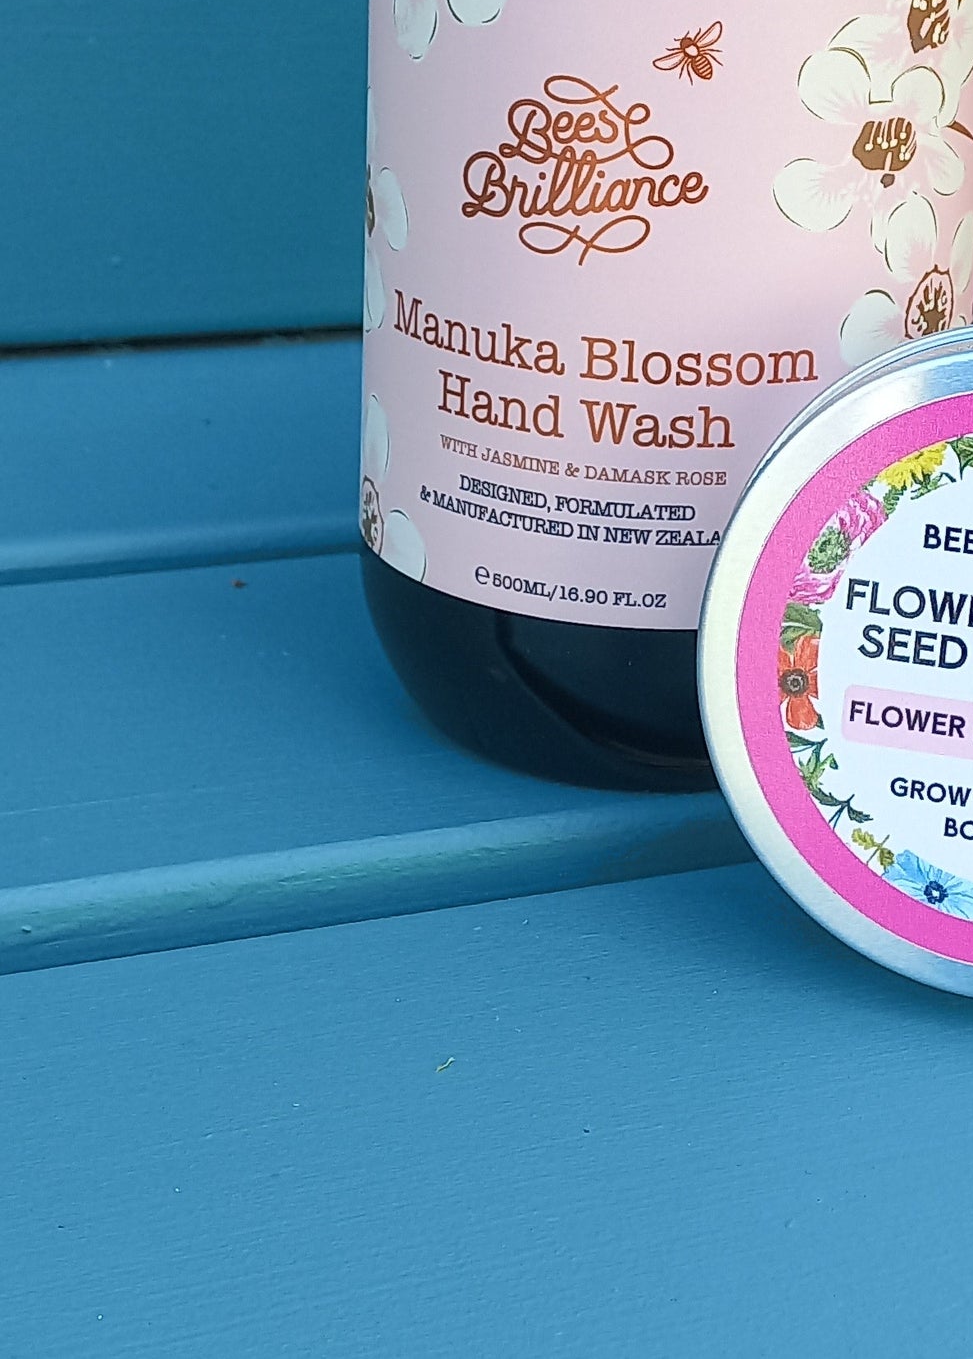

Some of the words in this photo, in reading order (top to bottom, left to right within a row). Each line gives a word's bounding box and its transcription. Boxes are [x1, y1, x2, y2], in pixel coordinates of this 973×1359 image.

[499, 87, 650, 166] Bees
[461, 146, 710, 219] Brilliance
[393, 288, 566, 377] Manuka
[579, 335, 818, 388] Blossom
[438, 369, 565, 439] Hand
[579, 398, 735, 449] Wash
[440, 433, 478, 459] WITH
[481, 447, 560, 476] JASMINE
[564, 462, 580, 478] &
[584, 465, 672, 486] DAMASK
[675, 471, 727, 486] ROSE
[432, 489, 574, 539] MANUFACTURED
[577, 523, 601, 541] IN
[603, 526, 652, 546] NEW
[458, 474, 551, 513] DESIGNED,
[554, 495, 696, 521] FORMULATED
[612, 591, 667, 609] FL.OZ
[857, 624, 969, 670] SEED
[849, 700, 966, 740] FLOWER
[889, 776, 972, 808] GROW
